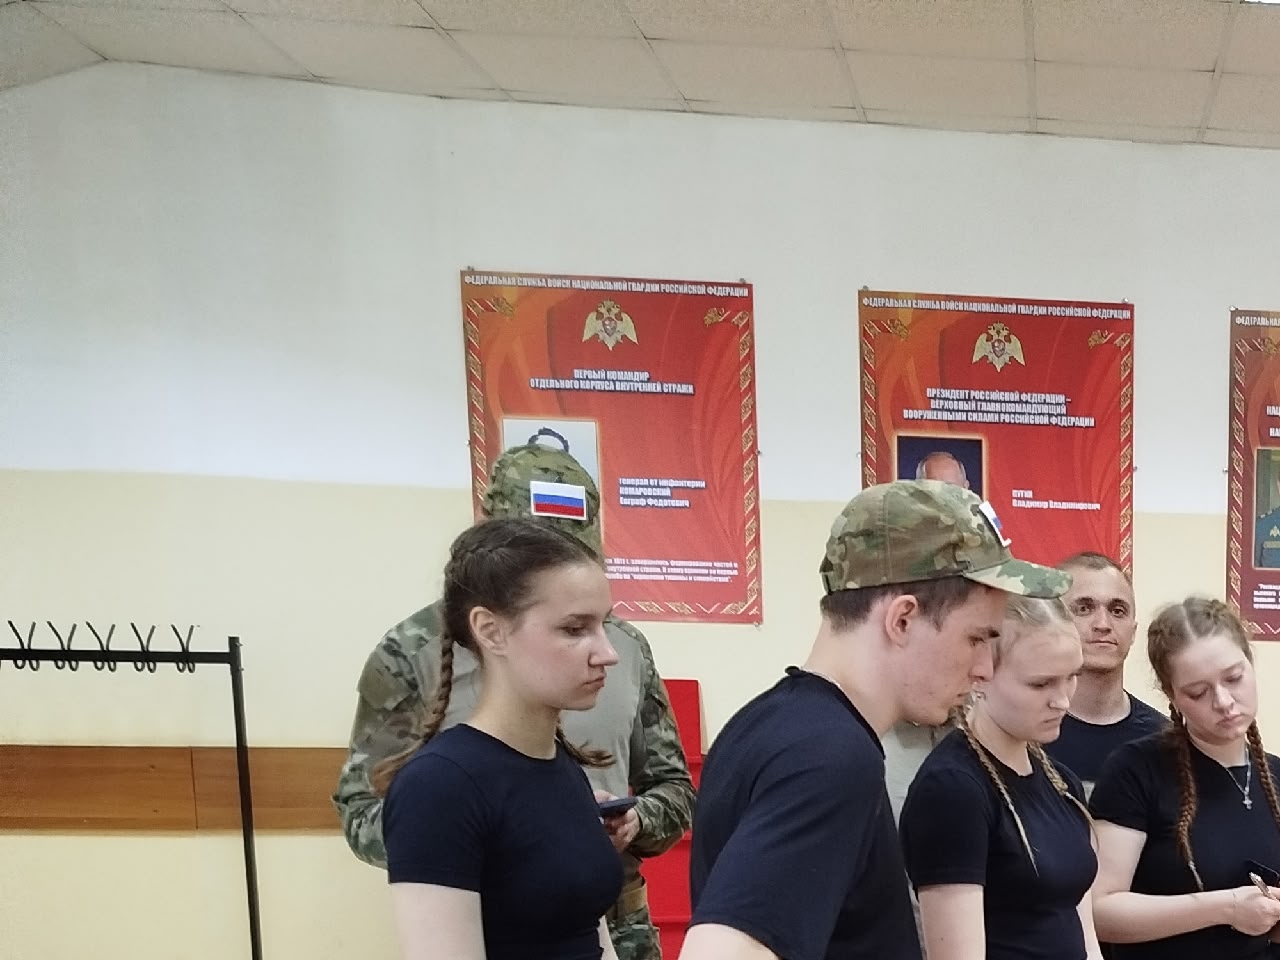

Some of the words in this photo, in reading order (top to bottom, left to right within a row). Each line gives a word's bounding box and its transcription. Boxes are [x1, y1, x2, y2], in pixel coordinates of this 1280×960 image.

[464, 275, 516, 286] ФЕДЕРАЛЬНАЯ
[628, 281, 660, 293] ГВАРДИИ
[661, 283, 706, 294] РОССИЙСКОЙ
[707, 285, 749, 297] ФЕДЕРАЦИИ
[862, 297, 912, 308] ФЕДЕРАЛЬНАЯ
[912, 299, 940, 309] СЛУЖБА
[941, 300, 964, 310] ВОЙСК
[964, 301, 1016, 313] НАЦИОНАЛЬНОЙ
[1017, 304, 1048, 316] ГВАРДИИ
[1048, 305, 1091, 317] РОССИЙСКОЙ
[1091, 308, 1131, 320] ФЕДЕРАЦИИ
[1235, 316, 1280, 327] ФЕДЕРАЛЬНАЯ
[573, 369, 605, 380] ПЕРВЫЙ
[606, 370, 650, 381] КОМАНДИР
[529, 378, 580, 389] ОТДЕЛЬНОГО
[580, 380, 614, 390] КОРПУСА
[615, 380, 662, 392] ВНУТРЕННЕЙ
[663, 383, 694, 394] СТРАЖИ
[926, 388, 969, 400] ПРЕЗИДЕНТ
[970, 389, 1020, 401] РОССИЙСКОЙ
[1020, 392, 1065, 404] ФЕДЕРАЦИИ
[930, 399, 977, 410] ВЕРХОВНЫЙ
[977, 401, 1066, 415] ГЛАВНОКОМАНДУЮЩИЙ
[903, 410, 967, 421] ВООРУЖЕННЫМИ
[967, 411, 999, 422] СИЛАМИ
[1000, 412, 1049, 425] РОССИЙСКОЙ
[1049, 415, 1095, 427] ФЕДЕРАЦИИ
